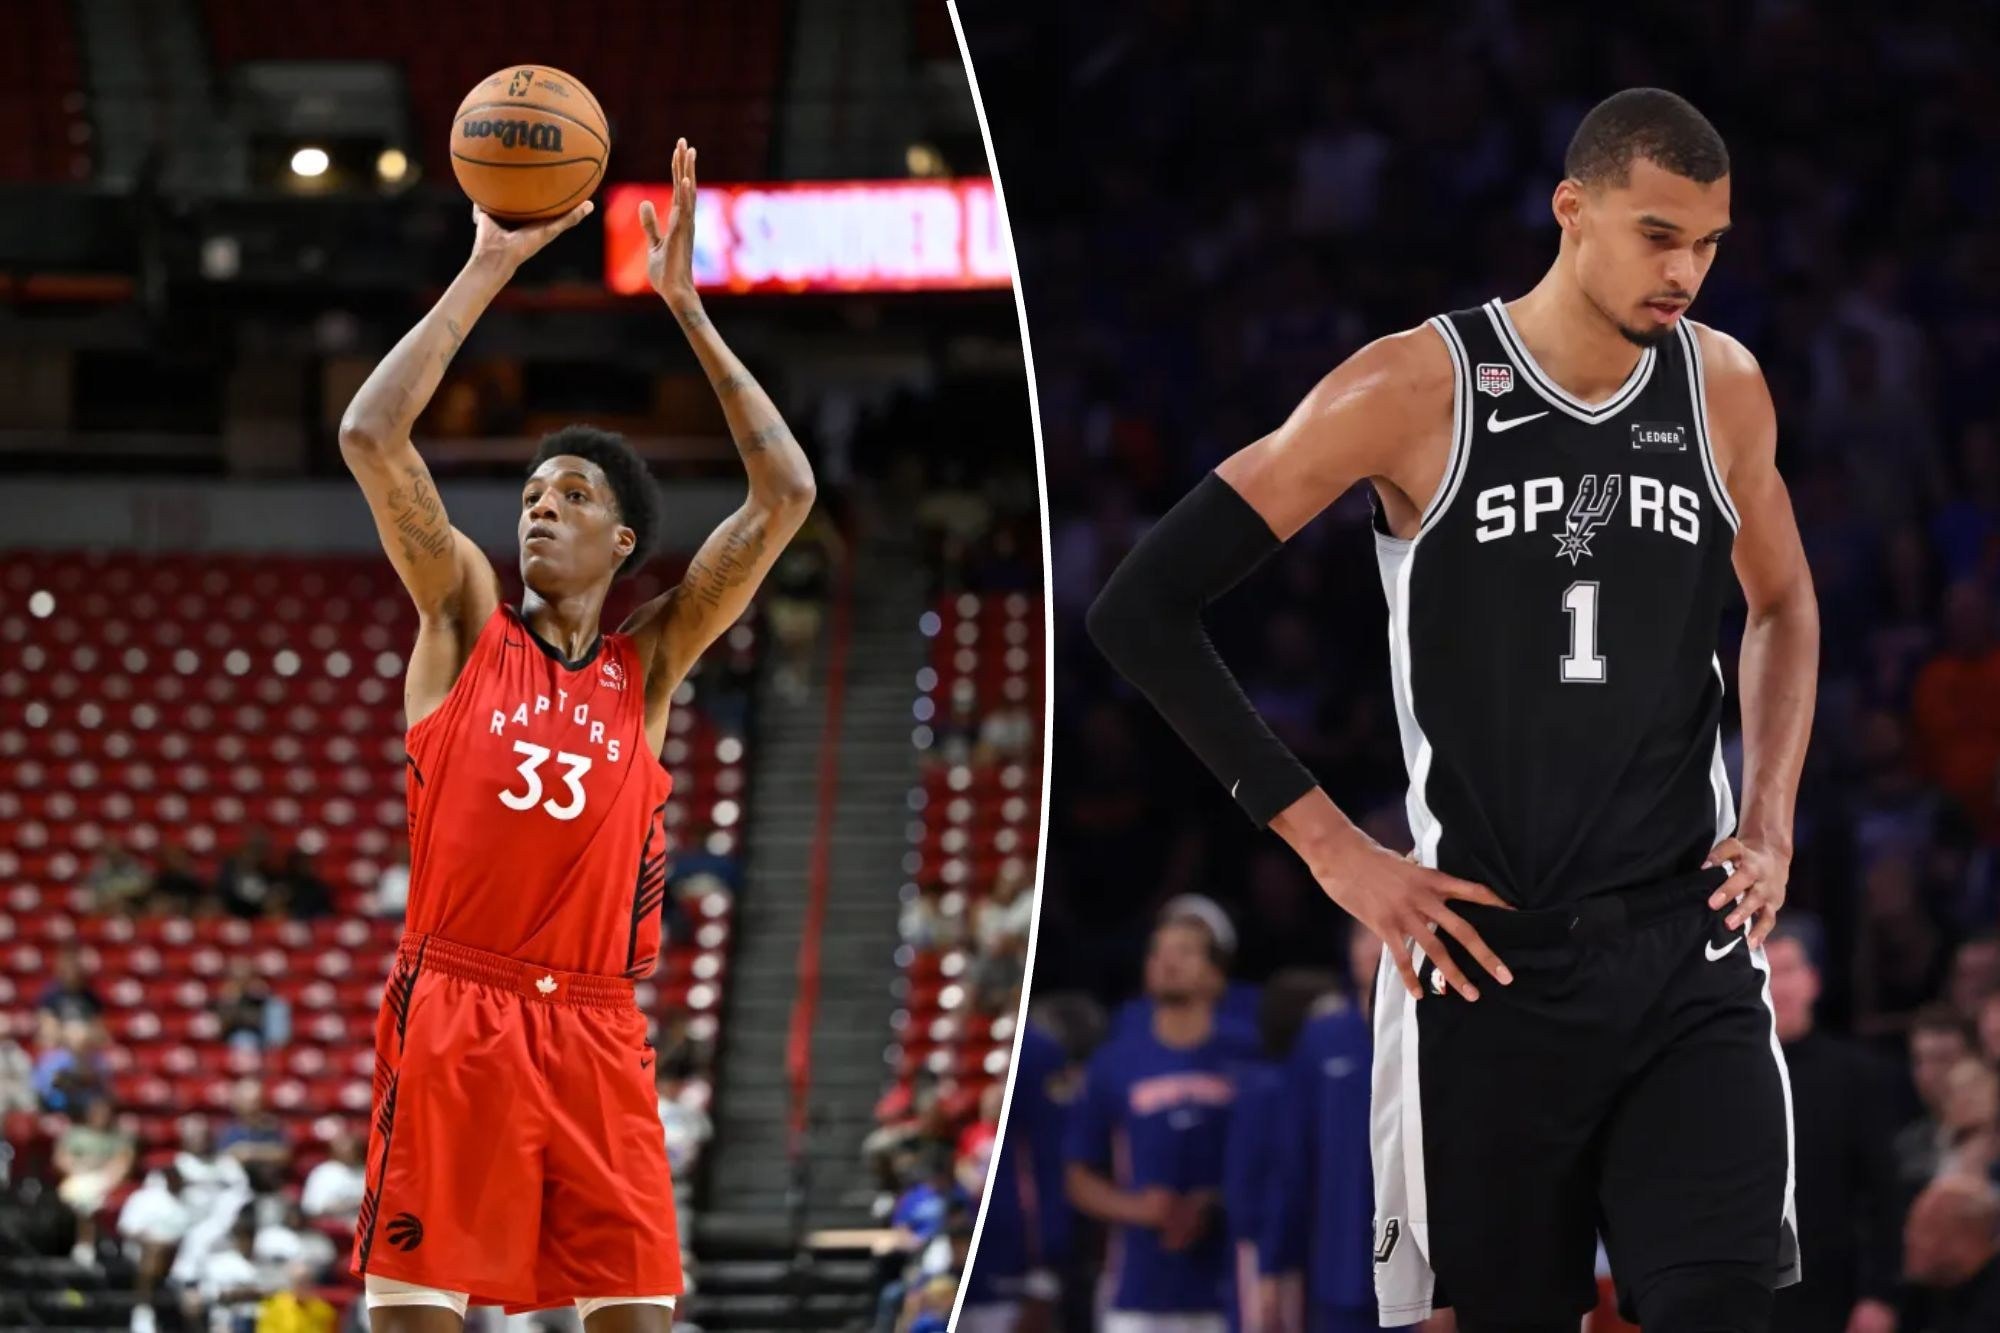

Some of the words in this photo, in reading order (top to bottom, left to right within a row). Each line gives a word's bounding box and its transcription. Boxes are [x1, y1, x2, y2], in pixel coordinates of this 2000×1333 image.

[463, 119, 563, 153] Wilson
[1481, 368, 1509, 376] USA
[1481, 380, 1510, 389] 250
[1639, 431, 1680, 443] LEDGER
[1475, 474, 1700, 566] SPURS
[1560, 580, 1606, 683] 1
[490, 688, 620, 762] RAPTORS
[498, 740, 592, 820] 33
